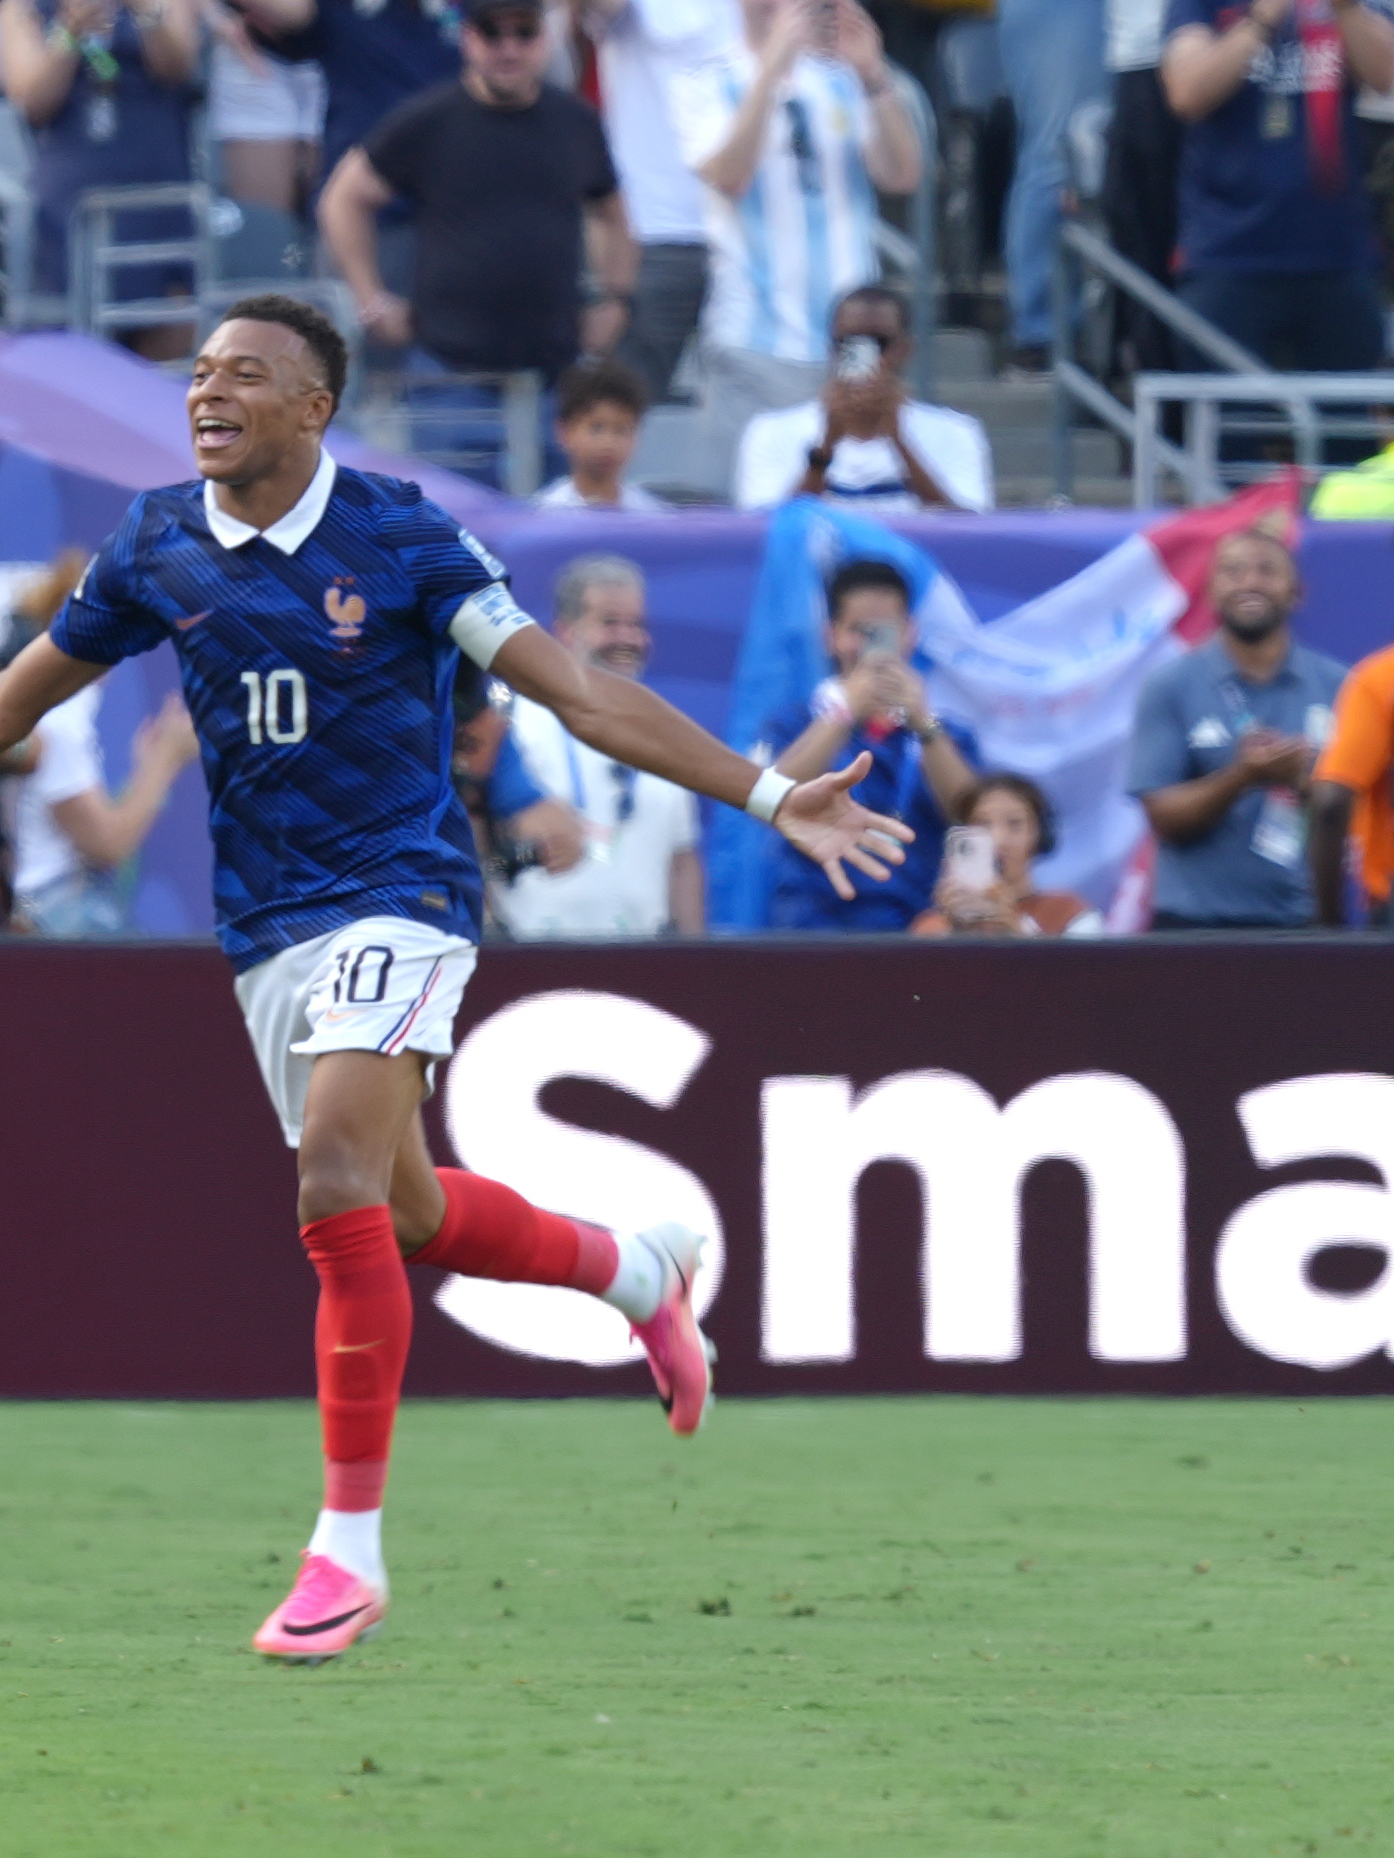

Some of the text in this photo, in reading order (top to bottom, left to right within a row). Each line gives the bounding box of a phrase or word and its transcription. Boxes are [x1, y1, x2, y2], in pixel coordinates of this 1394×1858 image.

[240, 668, 308, 745] 10
[334, 945, 394, 1004] 10
[435, 989, 1394, 1369] Sma
